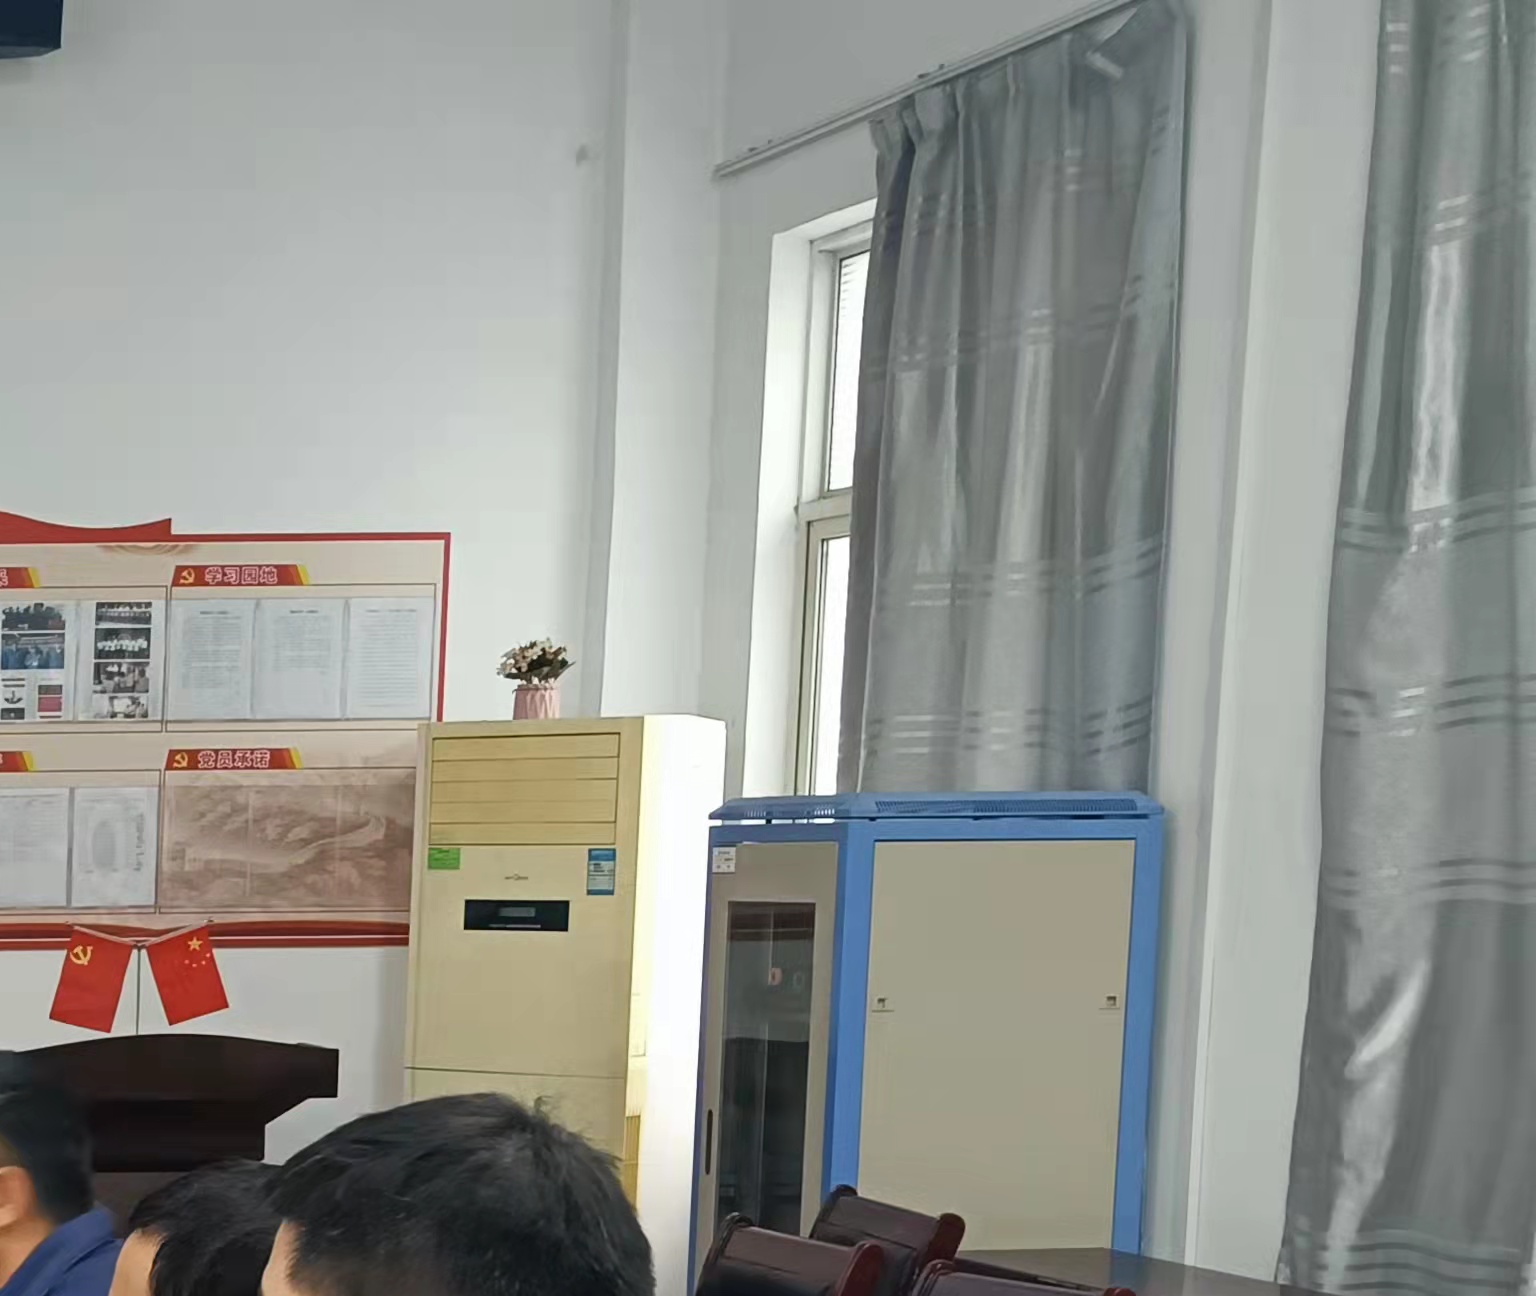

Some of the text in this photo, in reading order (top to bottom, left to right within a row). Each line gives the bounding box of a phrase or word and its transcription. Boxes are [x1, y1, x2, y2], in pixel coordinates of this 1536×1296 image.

[205, 566, 278, 585] 学习园地
[199, 749, 271, 769] 党员承诺
